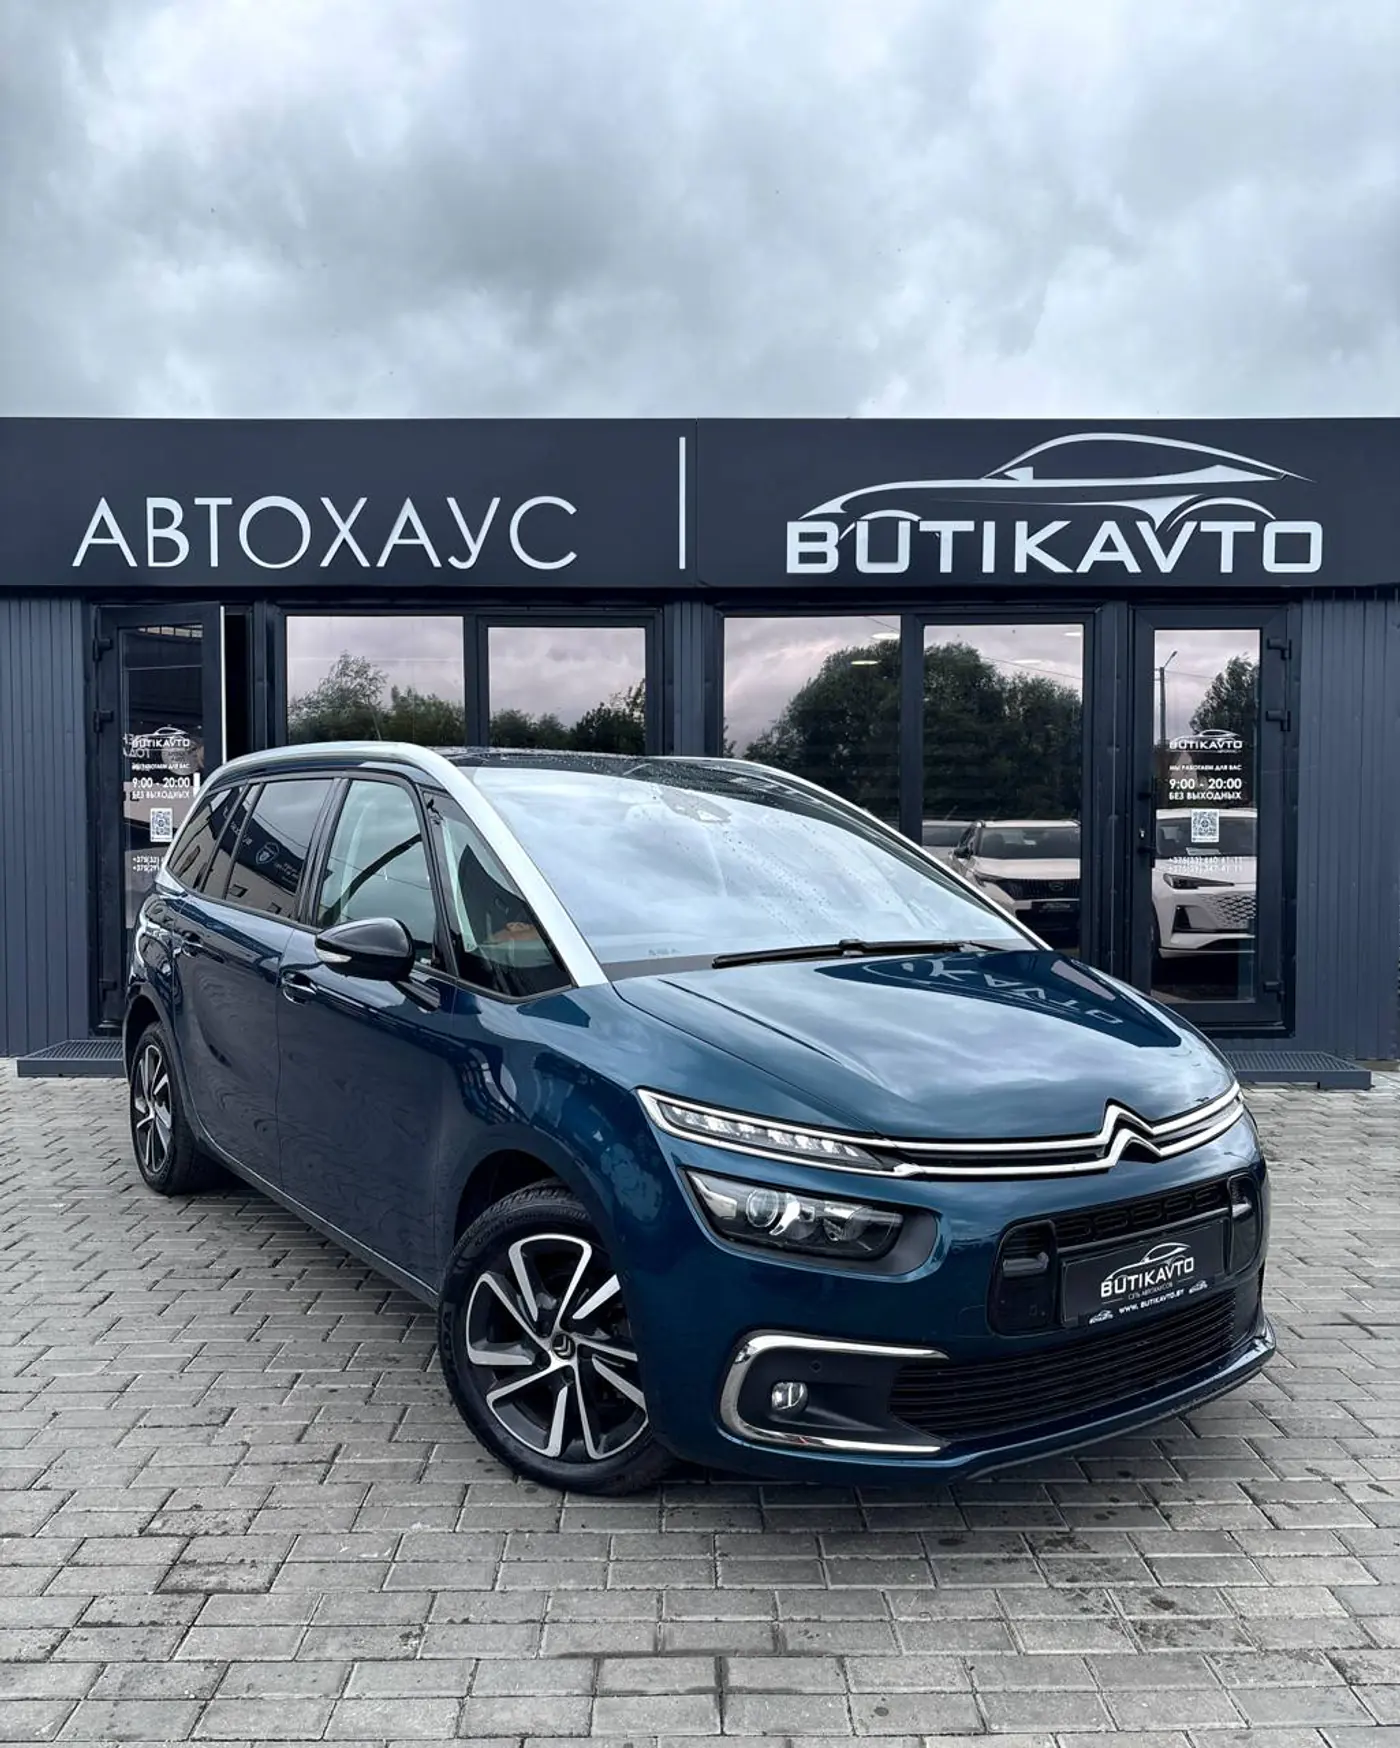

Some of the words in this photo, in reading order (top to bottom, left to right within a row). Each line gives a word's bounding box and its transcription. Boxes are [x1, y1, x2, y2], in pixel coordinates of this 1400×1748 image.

[72, 495, 578, 570] АВТОХАУС
[786, 519, 1324, 574] BUTIKAVTO
[1169, 740, 1243, 749] BUTIKAVTO
[132, 777, 153, 788] 9:00
[163, 777, 190, 788] 20:00
[1169, 778, 1195, 789] 9:00
[1208, 778, 1242, 789] 20:00
[1169, 791, 1184, 800] БЕЗ
[1187, 791, 1242, 800] ВЫХОДНЫХ
[1100, 1256, 1195, 1298] BUTIKAVTO
